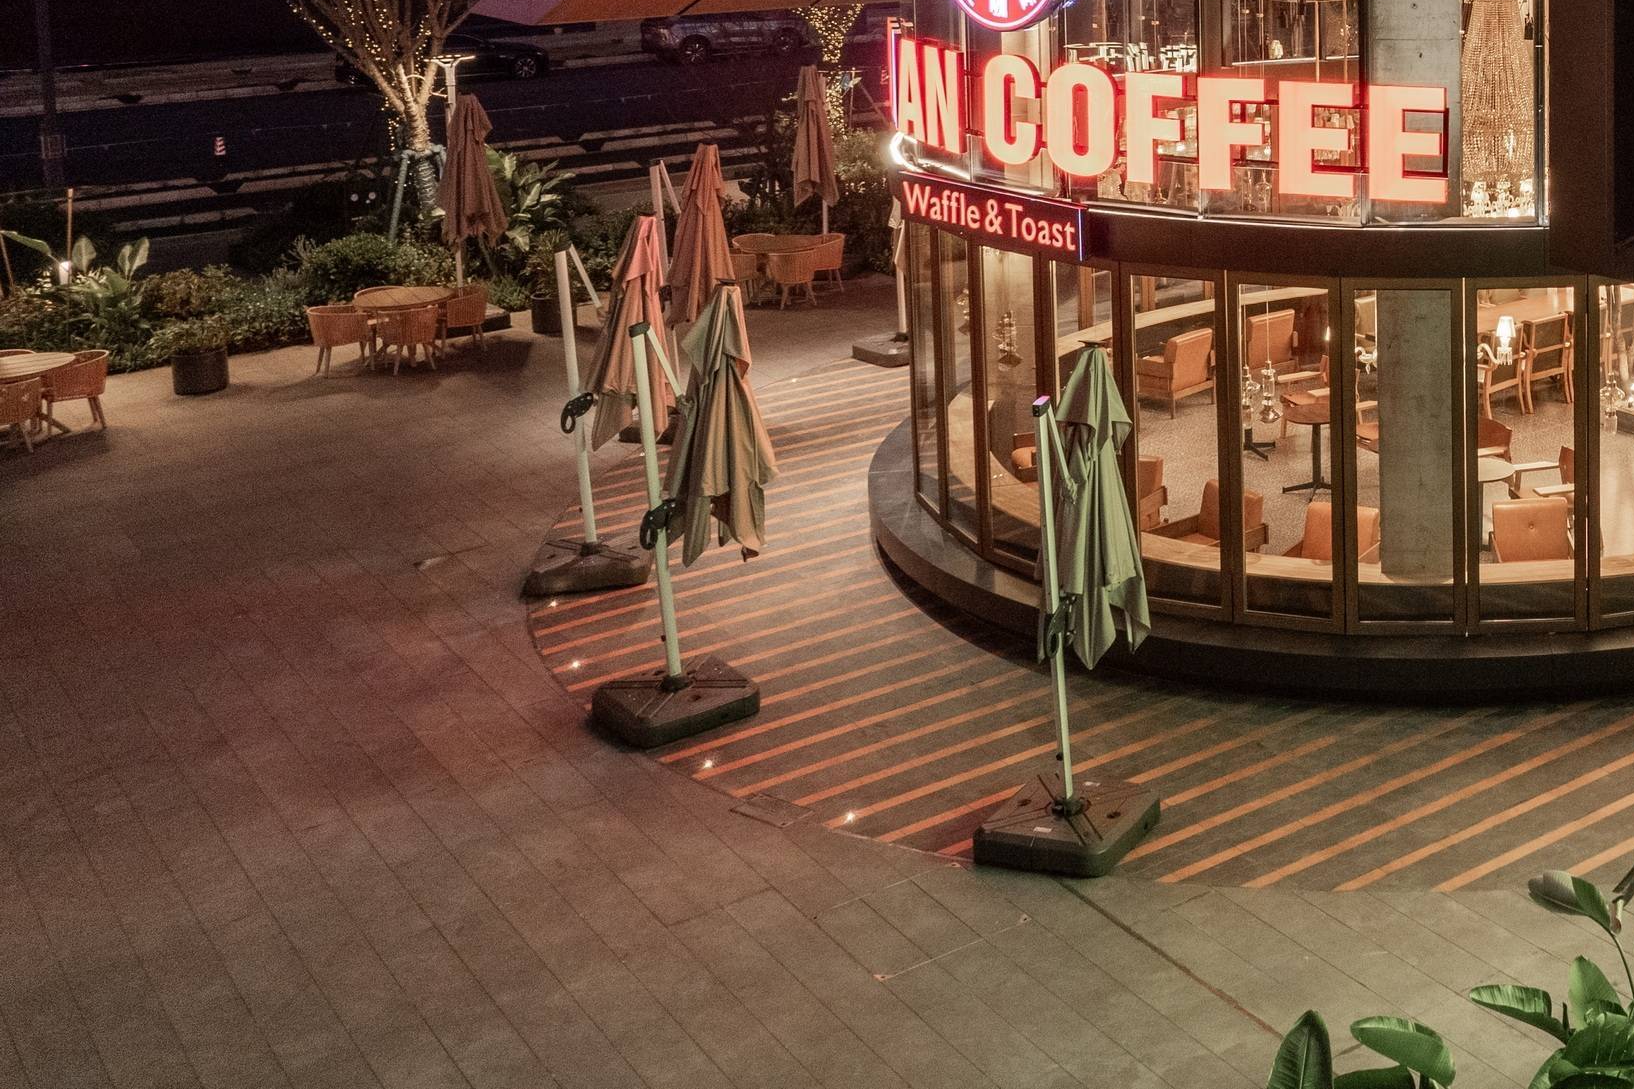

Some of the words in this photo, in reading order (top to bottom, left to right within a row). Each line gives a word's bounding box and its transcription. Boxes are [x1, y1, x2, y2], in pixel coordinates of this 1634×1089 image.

[889, 24, 963, 154] AN
[984, 54, 1448, 203] COFFEE
[903, 181, 981, 229] Waffle
[984, 199, 1003, 235] &
[1004, 202, 1076, 251] Toast
